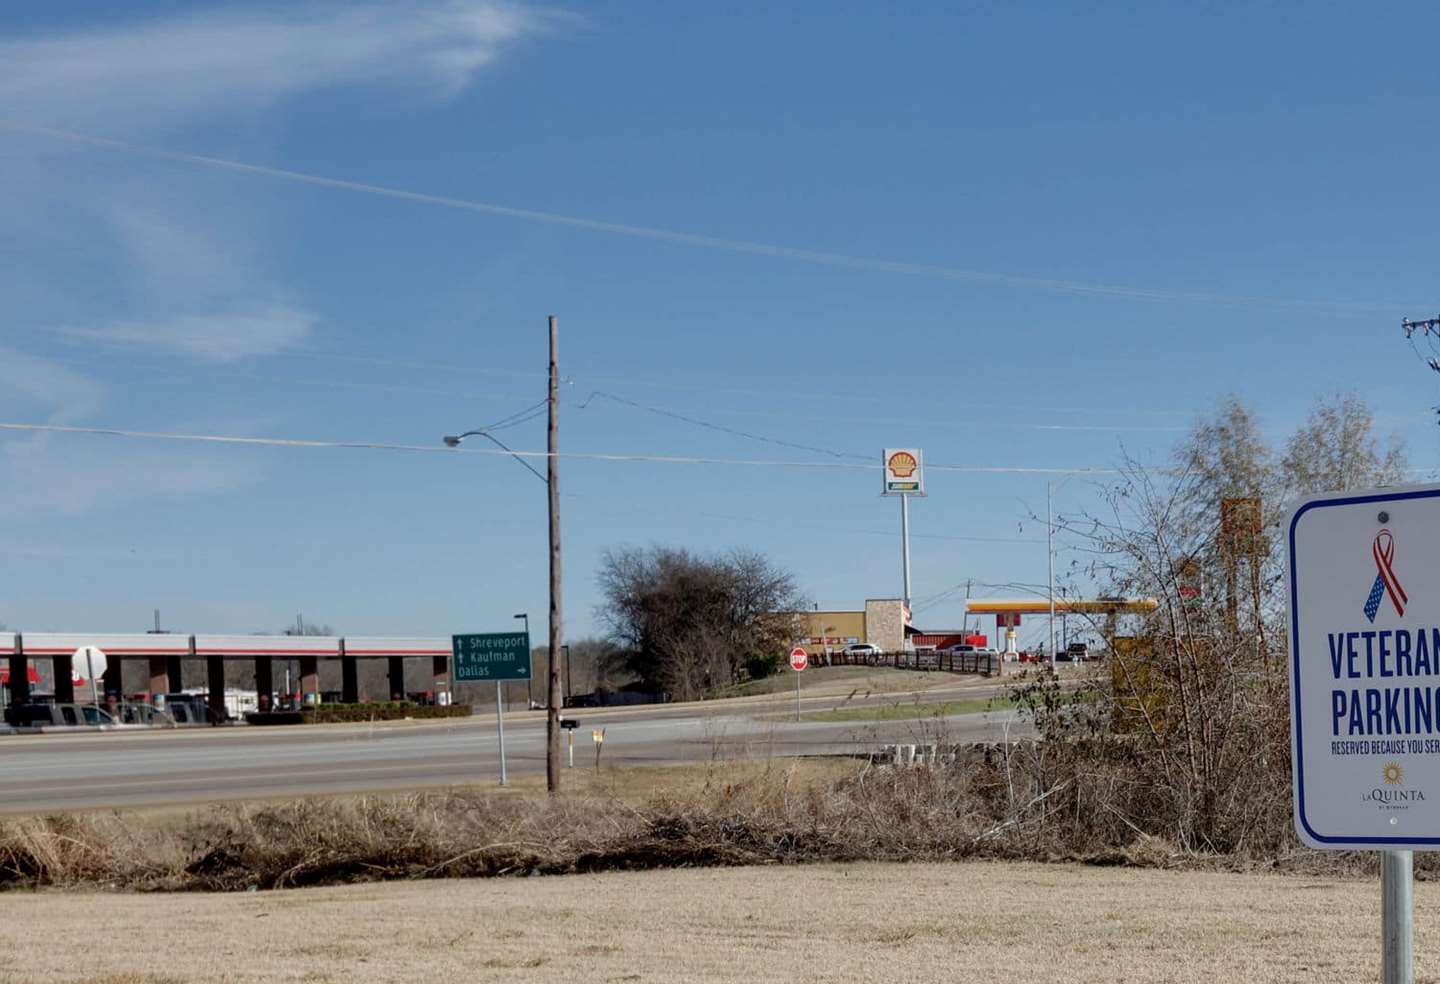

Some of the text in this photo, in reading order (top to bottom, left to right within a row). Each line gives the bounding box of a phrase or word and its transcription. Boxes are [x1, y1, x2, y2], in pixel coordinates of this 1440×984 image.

[470, 636, 525, 650] Shreveport
[470, 651, 515, 662] Kaufman
[792, 655, 806, 664] STOP
[459, 664, 489, 677] Dallas
[1331, 741, 1369, 755] RESERVED
[1371, 740, 1405, 754] BECAUSE
[1407, 740, 1423, 754] YOU
